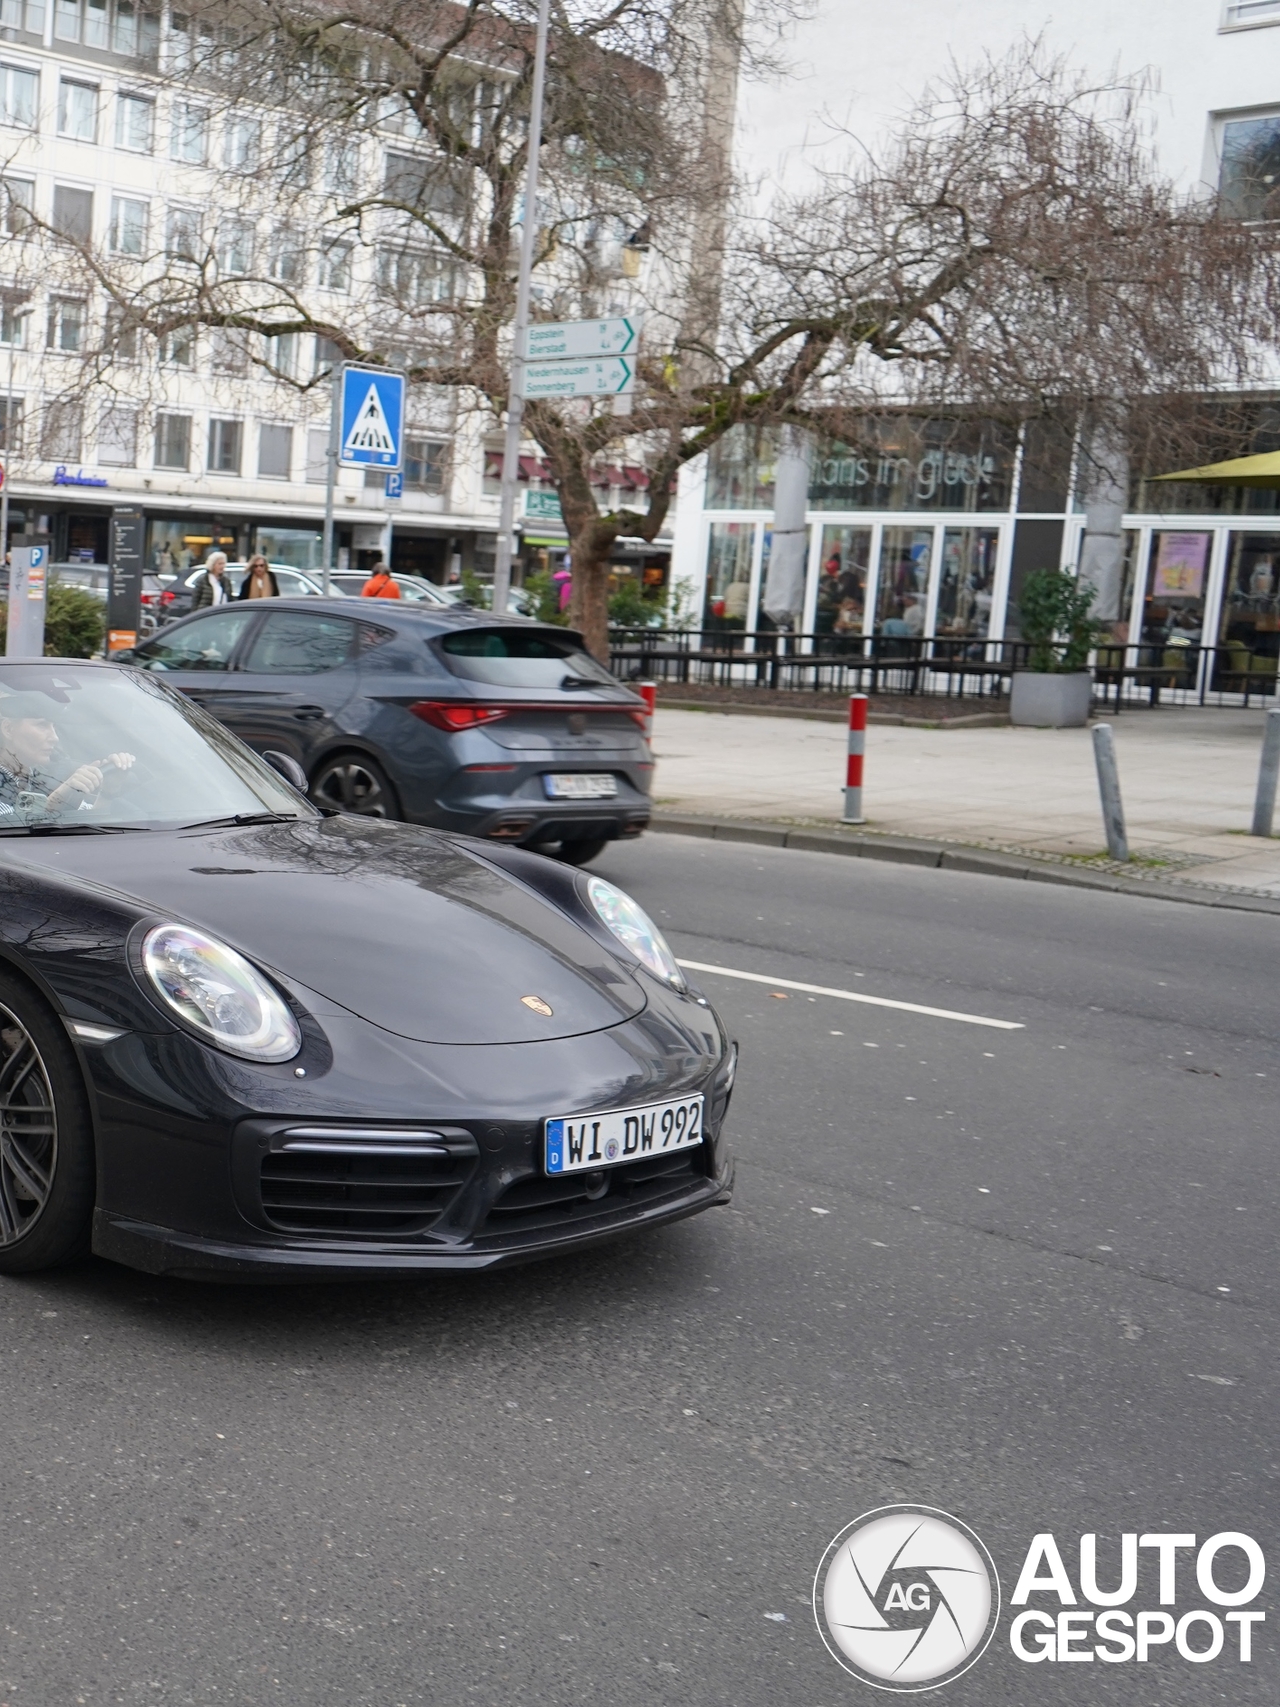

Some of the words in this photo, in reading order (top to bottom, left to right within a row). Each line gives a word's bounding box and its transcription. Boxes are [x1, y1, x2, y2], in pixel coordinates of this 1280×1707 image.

[529, 329, 565, 341] Eppstein
[529, 343, 567, 354] Bierstadt
[527, 366, 590, 378] Niedernhausen
[526, 381, 576, 393] Sonnenberg
[31, 549, 41, 565] P
[551, 1152, 559, 1165] D
[568, 1122, 602, 1164] WI
[623, 1111, 657, 1155] DW
[661, 1102, 700, 1147] 992
